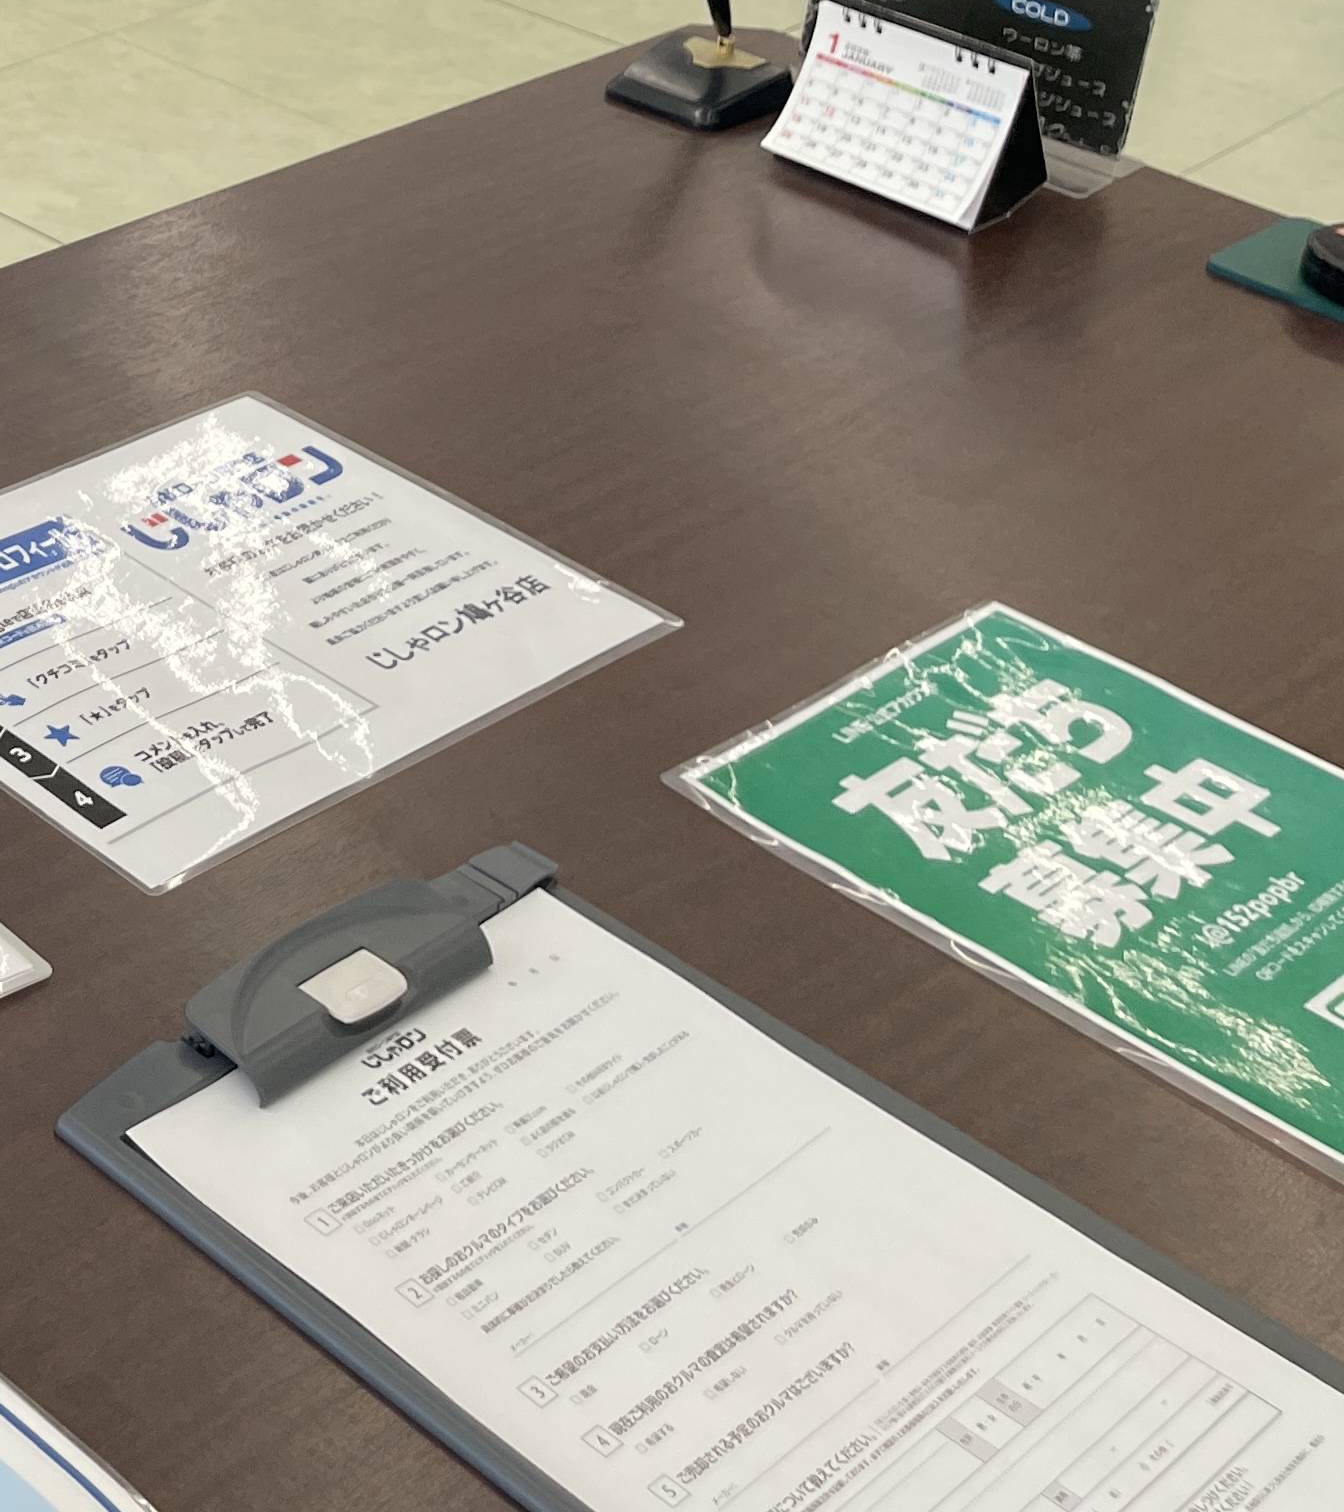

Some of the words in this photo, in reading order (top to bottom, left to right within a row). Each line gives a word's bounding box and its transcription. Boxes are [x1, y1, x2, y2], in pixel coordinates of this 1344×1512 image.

[7, 746, 34, 762] 3
[832, 678, 1132, 861] 友だち
[68, 790, 97, 808] 4
[978, 758, 1282, 948] 募集中
[361, 1029, 482, 1104] ご利用受付票
